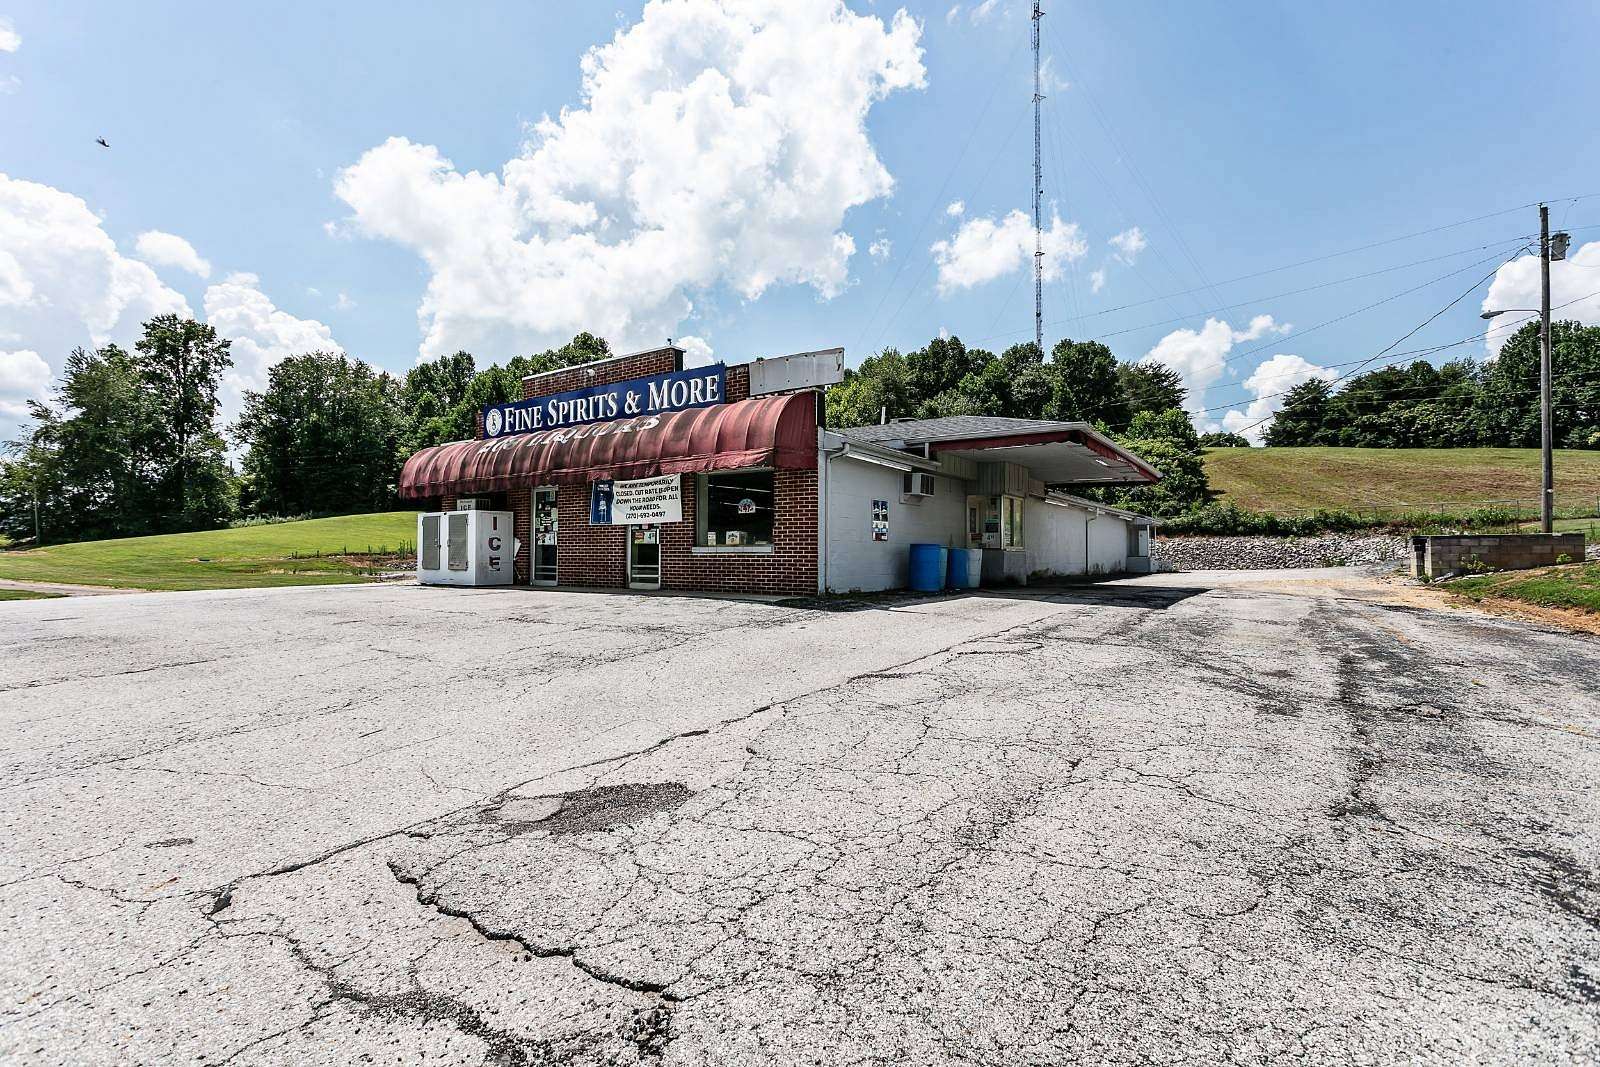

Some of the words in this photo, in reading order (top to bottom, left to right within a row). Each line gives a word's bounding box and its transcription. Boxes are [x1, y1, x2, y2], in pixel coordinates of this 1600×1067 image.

[503, 405, 543, 433] FINE
[548, 392, 618, 427] SPIRITS
[624, 390, 641, 414] &
[647, 375, 719, 411] MORE
[639, 479, 674, 487] TEMPORARILY
